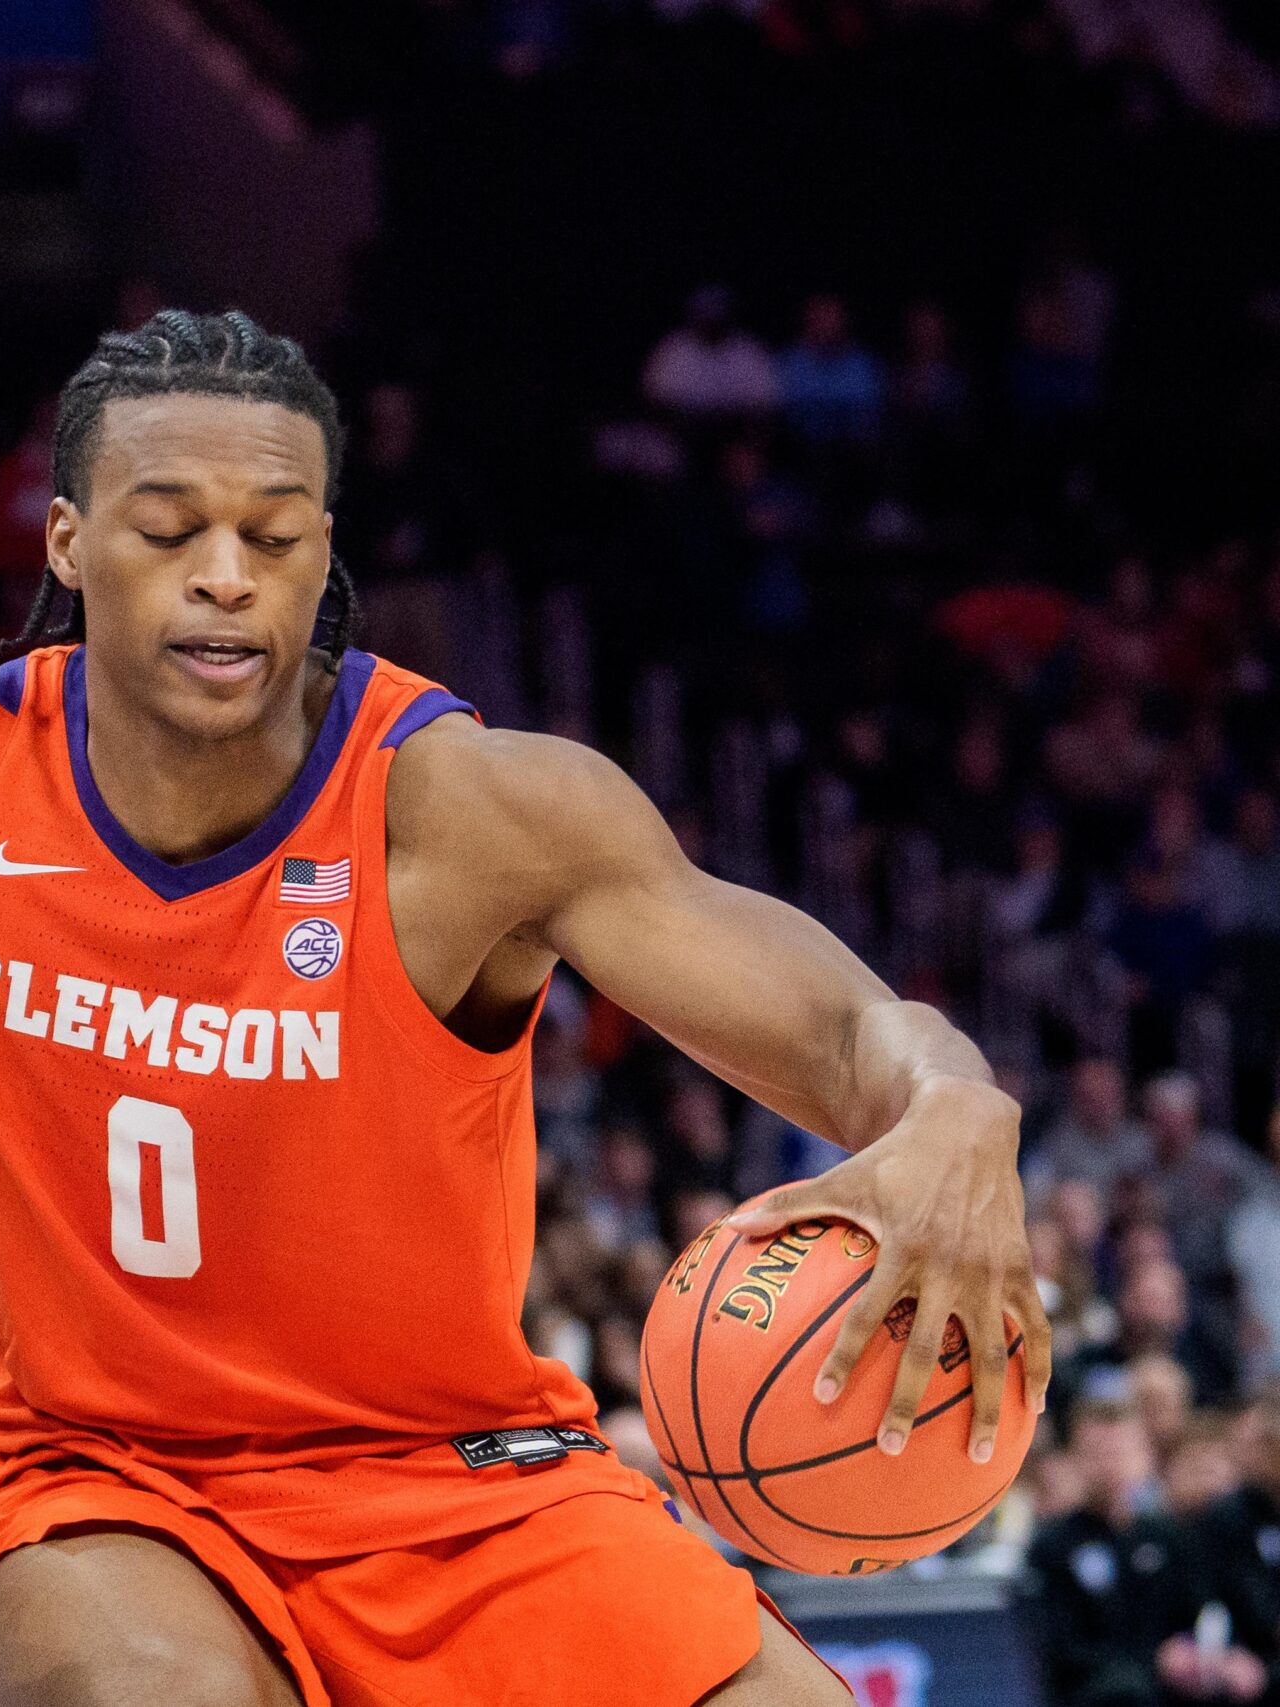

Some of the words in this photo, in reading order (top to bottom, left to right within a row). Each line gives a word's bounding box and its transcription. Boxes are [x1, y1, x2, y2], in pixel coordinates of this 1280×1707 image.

[291, 937, 339, 952] ACC
[107, 1095, 202, 1279] 0
[717, 1220, 833, 1334] DING
[558, 1431, 585, 1441] 50
[470, 1446, 503, 1458] TEAM
